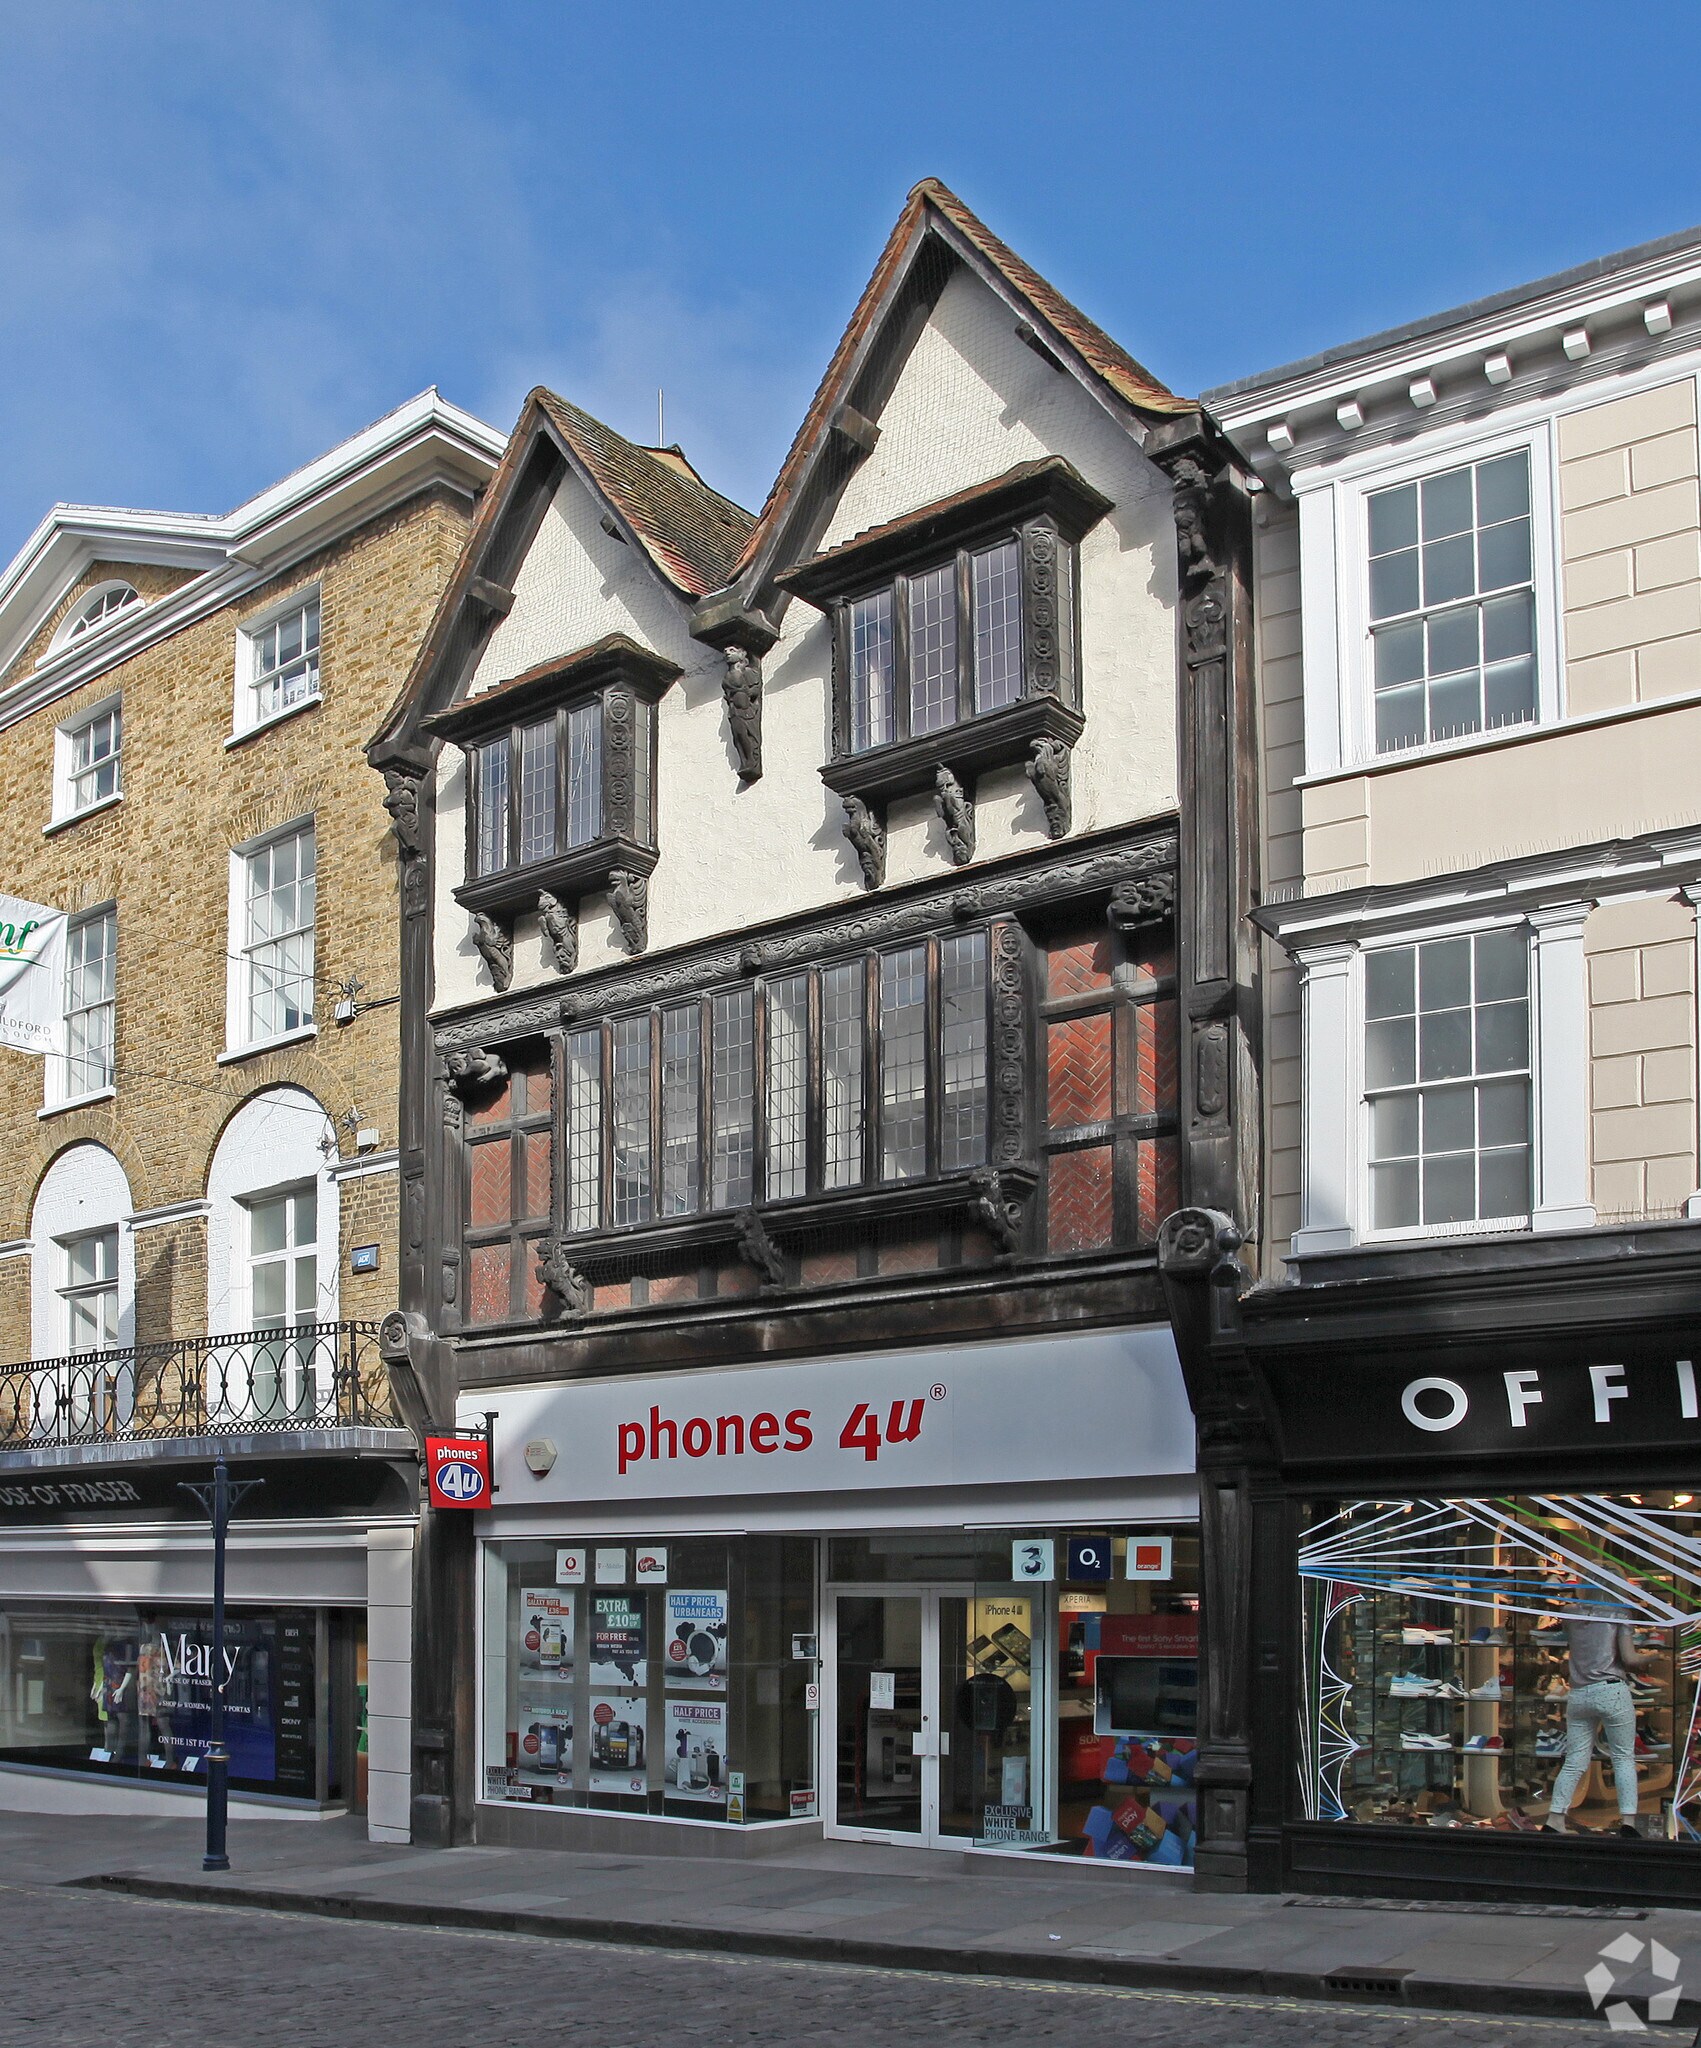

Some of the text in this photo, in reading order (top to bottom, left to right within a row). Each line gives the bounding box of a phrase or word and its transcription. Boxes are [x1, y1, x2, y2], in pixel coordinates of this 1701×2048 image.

[1401, 1361, 1699, 1431] OFFI
[618, 1404, 813, 1474] phones
[437, 1446, 479, 1460] phones
[442, 1464, 479, 1498] 4u
[31, 1485, 61, 1505] OF
[59, 1480, 141, 1503] FRASER
[1136, 1563, 1159, 1571] orange
[596, 1600, 628, 1612] EXTRA
[670, 1596, 716, 1606] HALF PRICE
[1064, 1595, 1092, 1605] XPERIA
[675, 1607, 722, 1618] URBANEARS
[985, 1604, 1011, 1616] iPhone
[607, 1614, 629, 1627] £10
[596, 1632, 610, 1641] FOR
[609, 1633, 627, 1641] FREE
[1122, 1634, 1136, 1643] The
[1152, 1634, 1172, 1644] Sony
[159, 1632, 241, 1694] Mary
[162, 1700, 177, 1708] SHOP
[183, 1701, 206, 1710] WOMEN
[228, 1704, 251, 1714] PORTAS
[674, 1706, 718, 1719] HALF PRICE
[158, 1735, 170, 1744] ON
[170, 1736, 185, 1745] THE
[185, 1737, 198, 1747] 1ST
[487, 1776, 506, 1786] WHITE
[487, 1785, 531, 1797] PHONE RANGE
[984, 1804, 1032, 1818] EXCLUSIVE
[984, 1817, 1015, 1829] WHITE
[1121, 1811, 1138, 1828] play
[984, 1829, 1050, 1843] PHONE RANGE
